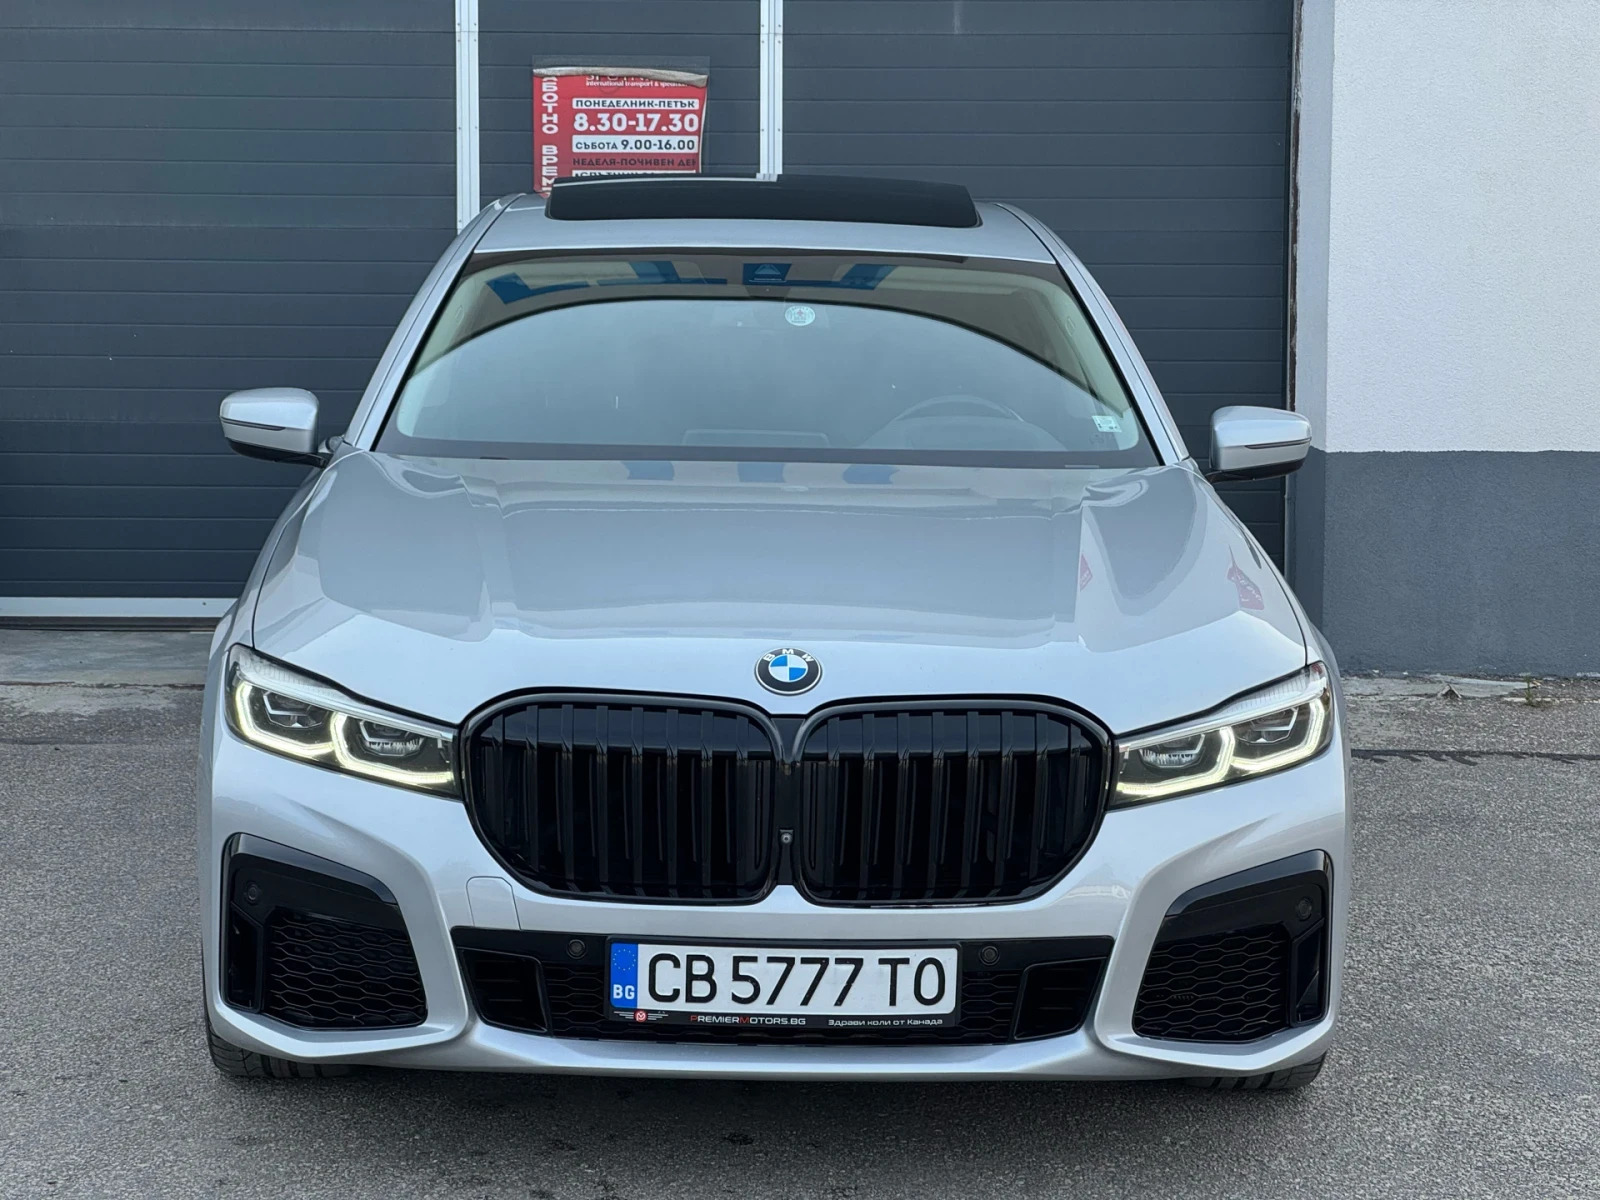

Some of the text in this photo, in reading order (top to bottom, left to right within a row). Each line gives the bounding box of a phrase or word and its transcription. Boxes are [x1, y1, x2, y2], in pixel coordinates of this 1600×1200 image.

[575, 99, 695, 108] ПОНЕДЕЛНИК-ПЕТЪК
[573, 112, 699, 132] 8.30-17.30
[575, 139, 695, 151] СЪБОТА 9.00-16.00
[572, 158, 674, 166] НЕДЕЛЯ-ПОЧИВЕН
[762, 648, 815, 662] BMW
[648, 953, 946, 1007] CB 5777 TO
[612, 984, 635, 1000] BG
[690, 1015, 806, 1026] PREMIERMOTORS.BG
[828, 1019, 865, 1027] Здрави
[867, 1019, 892, 1027] коли
[907, 1018, 943, 1026] Канада
